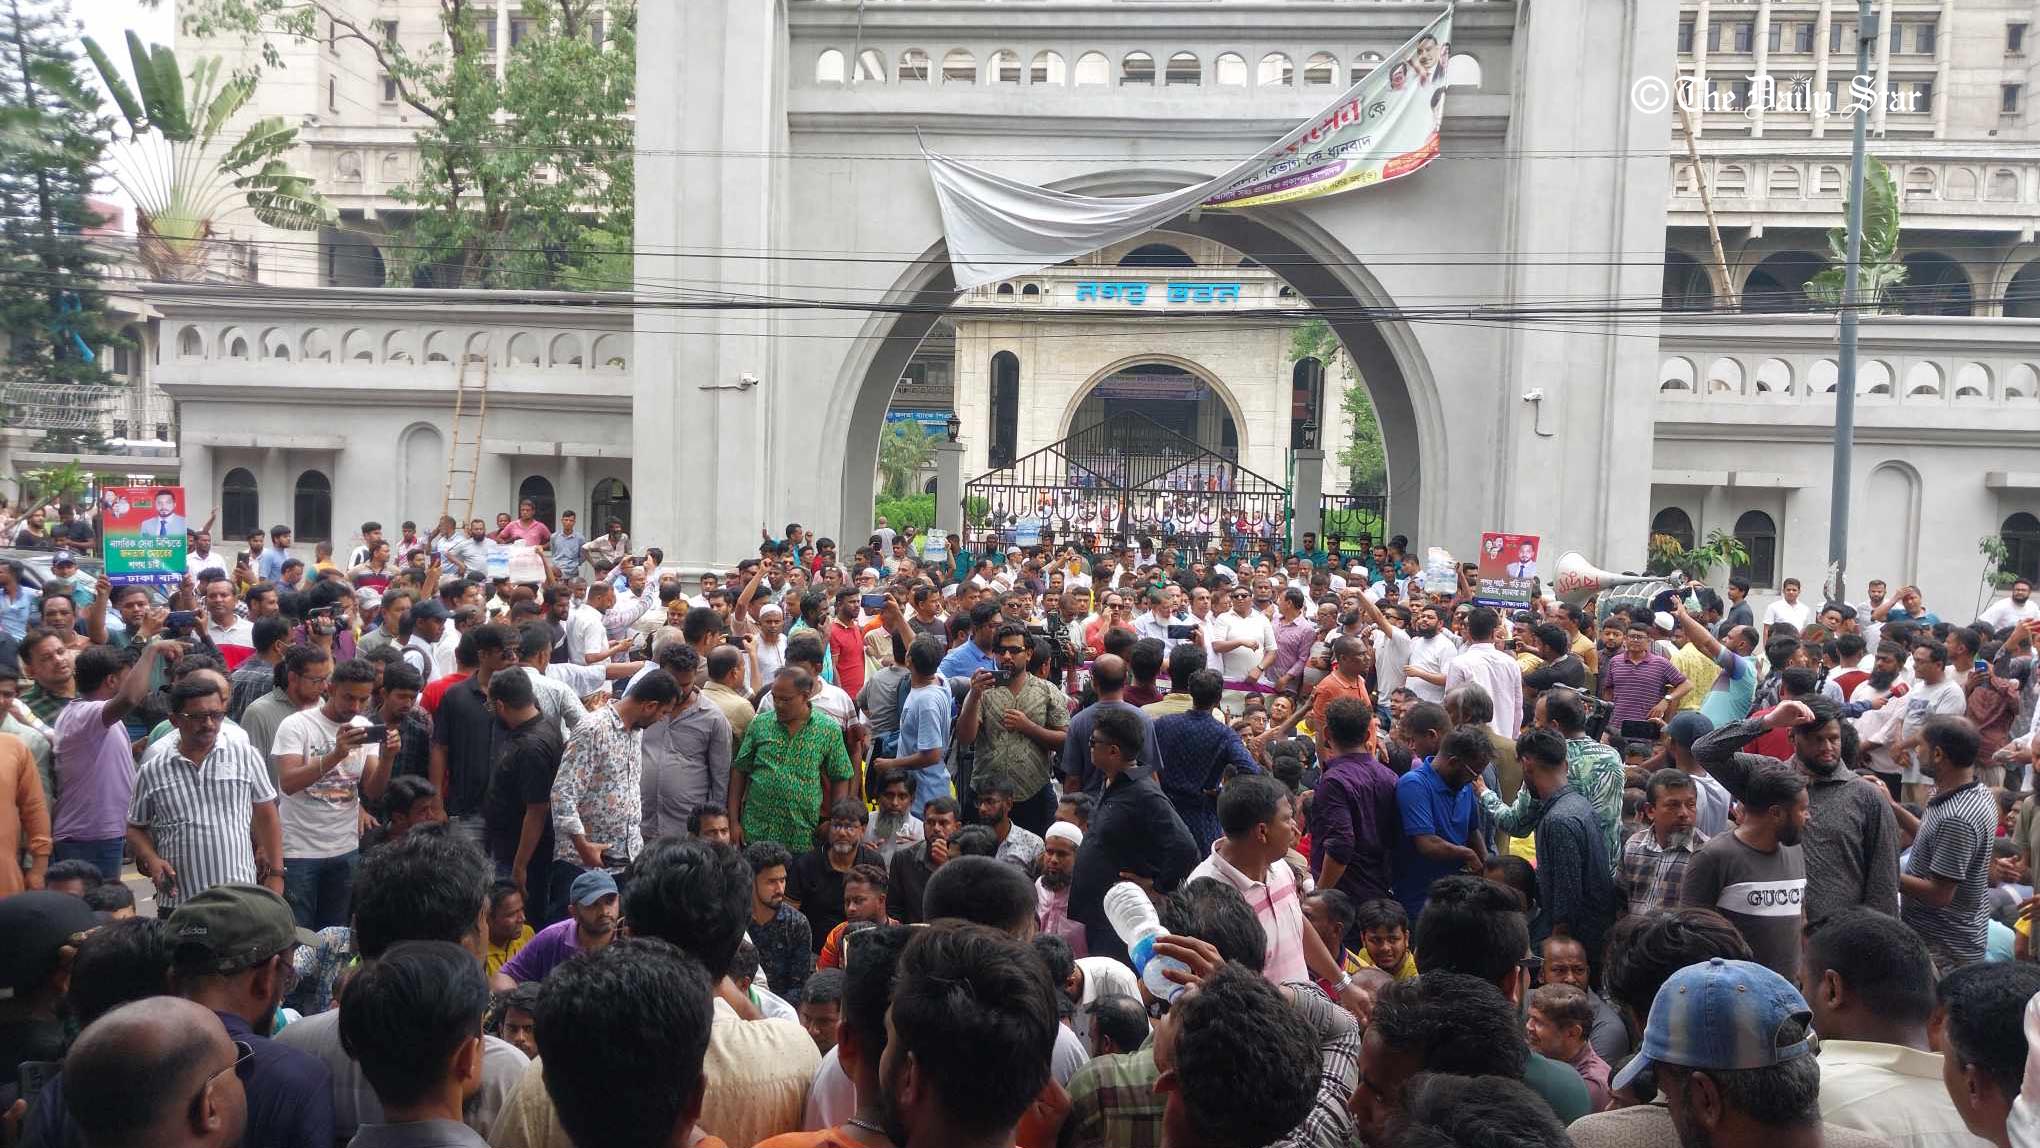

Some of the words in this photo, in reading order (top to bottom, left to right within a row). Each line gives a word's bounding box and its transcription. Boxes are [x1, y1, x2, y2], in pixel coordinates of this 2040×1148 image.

[1306, 150, 1322, 166] কে
[1075, 281, 1149, 305] নগর
[1168, 282, 1241, 304] ভবন
[110, 537, 136, 549] নাগরিক
[137, 538, 154, 549] সেবা
[128, 560, 146, 570] শপথ
[126, 574, 154, 583] ঢাকা
[158, 572, 183, 583] বাসী
[1747, 888, 1800, 907] GUCC
